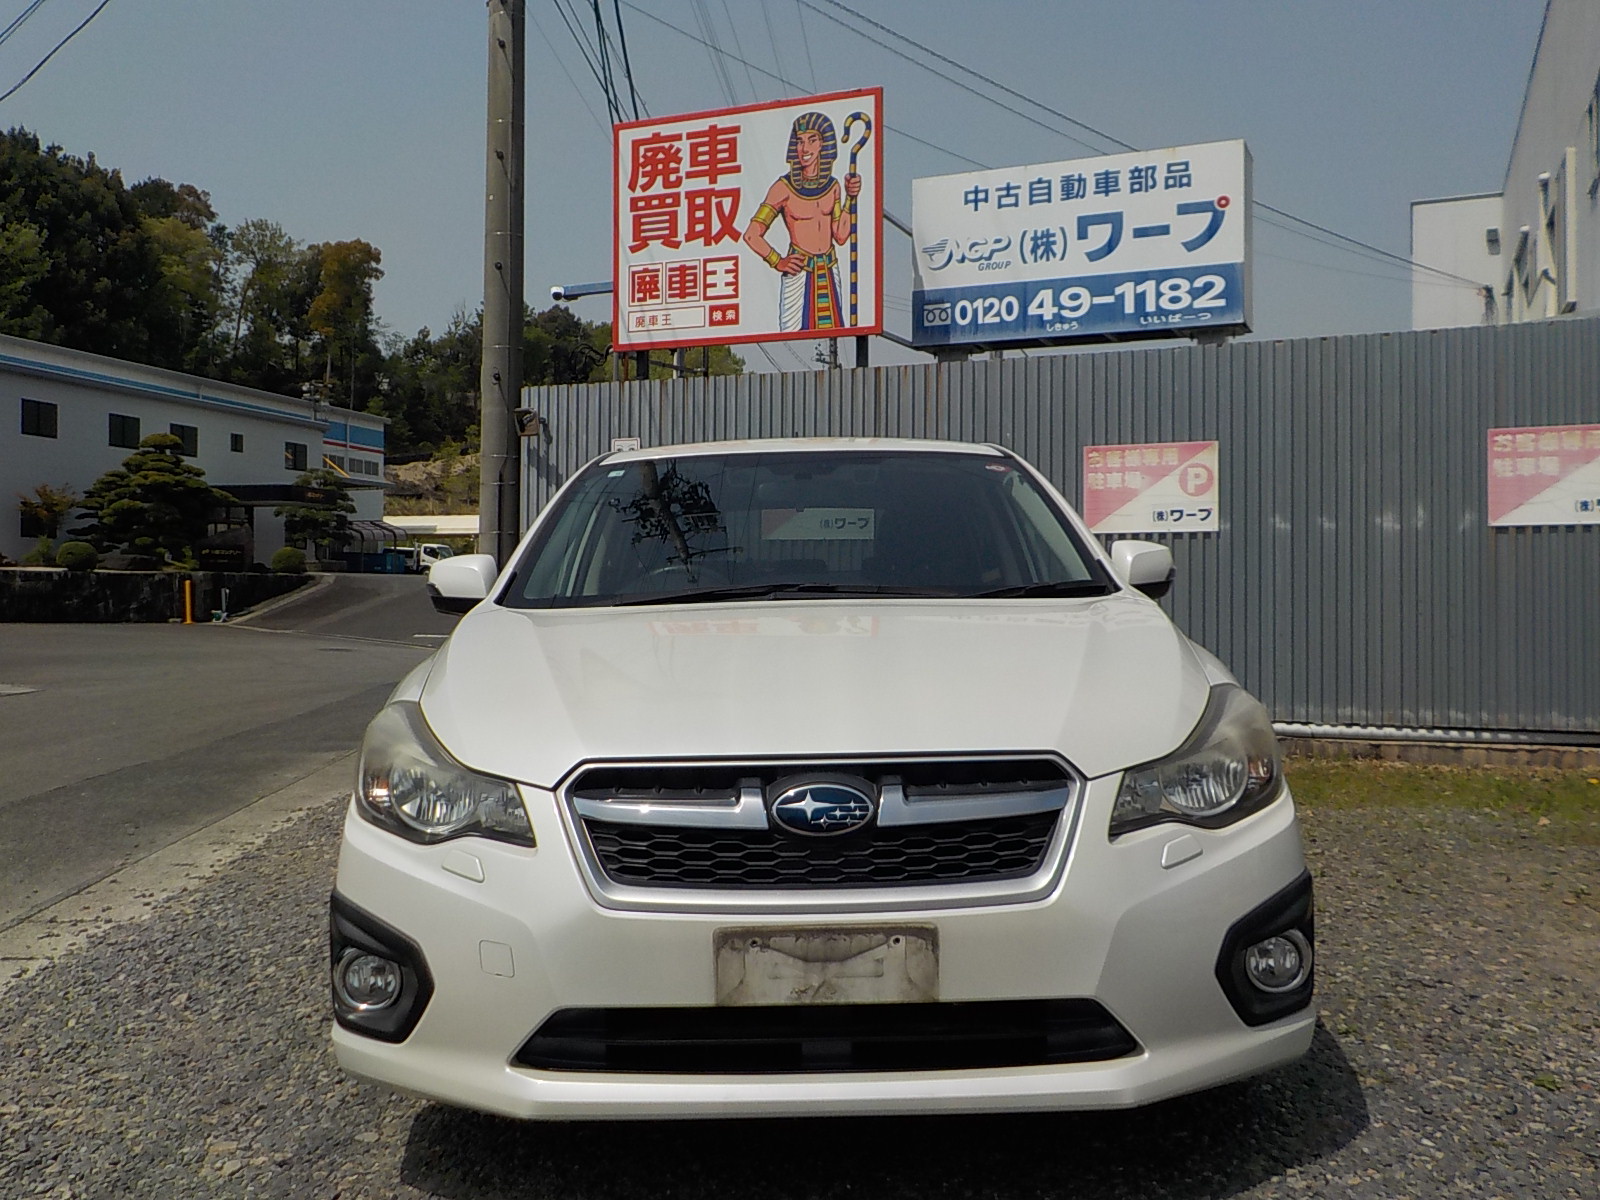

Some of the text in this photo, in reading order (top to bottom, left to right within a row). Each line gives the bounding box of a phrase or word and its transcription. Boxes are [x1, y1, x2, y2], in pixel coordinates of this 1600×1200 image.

[627, 124, 742, 193] 廃車
[962, 160, 1193, 213] 中古自動車部品
[627, 187, 742, 254] 買取
[629, 256, 739, 306] 廃車王
[977, 260, 1012, 272] GROUP
[634, 309, 737, 329] 廃車王 検索
[954, 274, 1227, 326] 0120 49-1182
